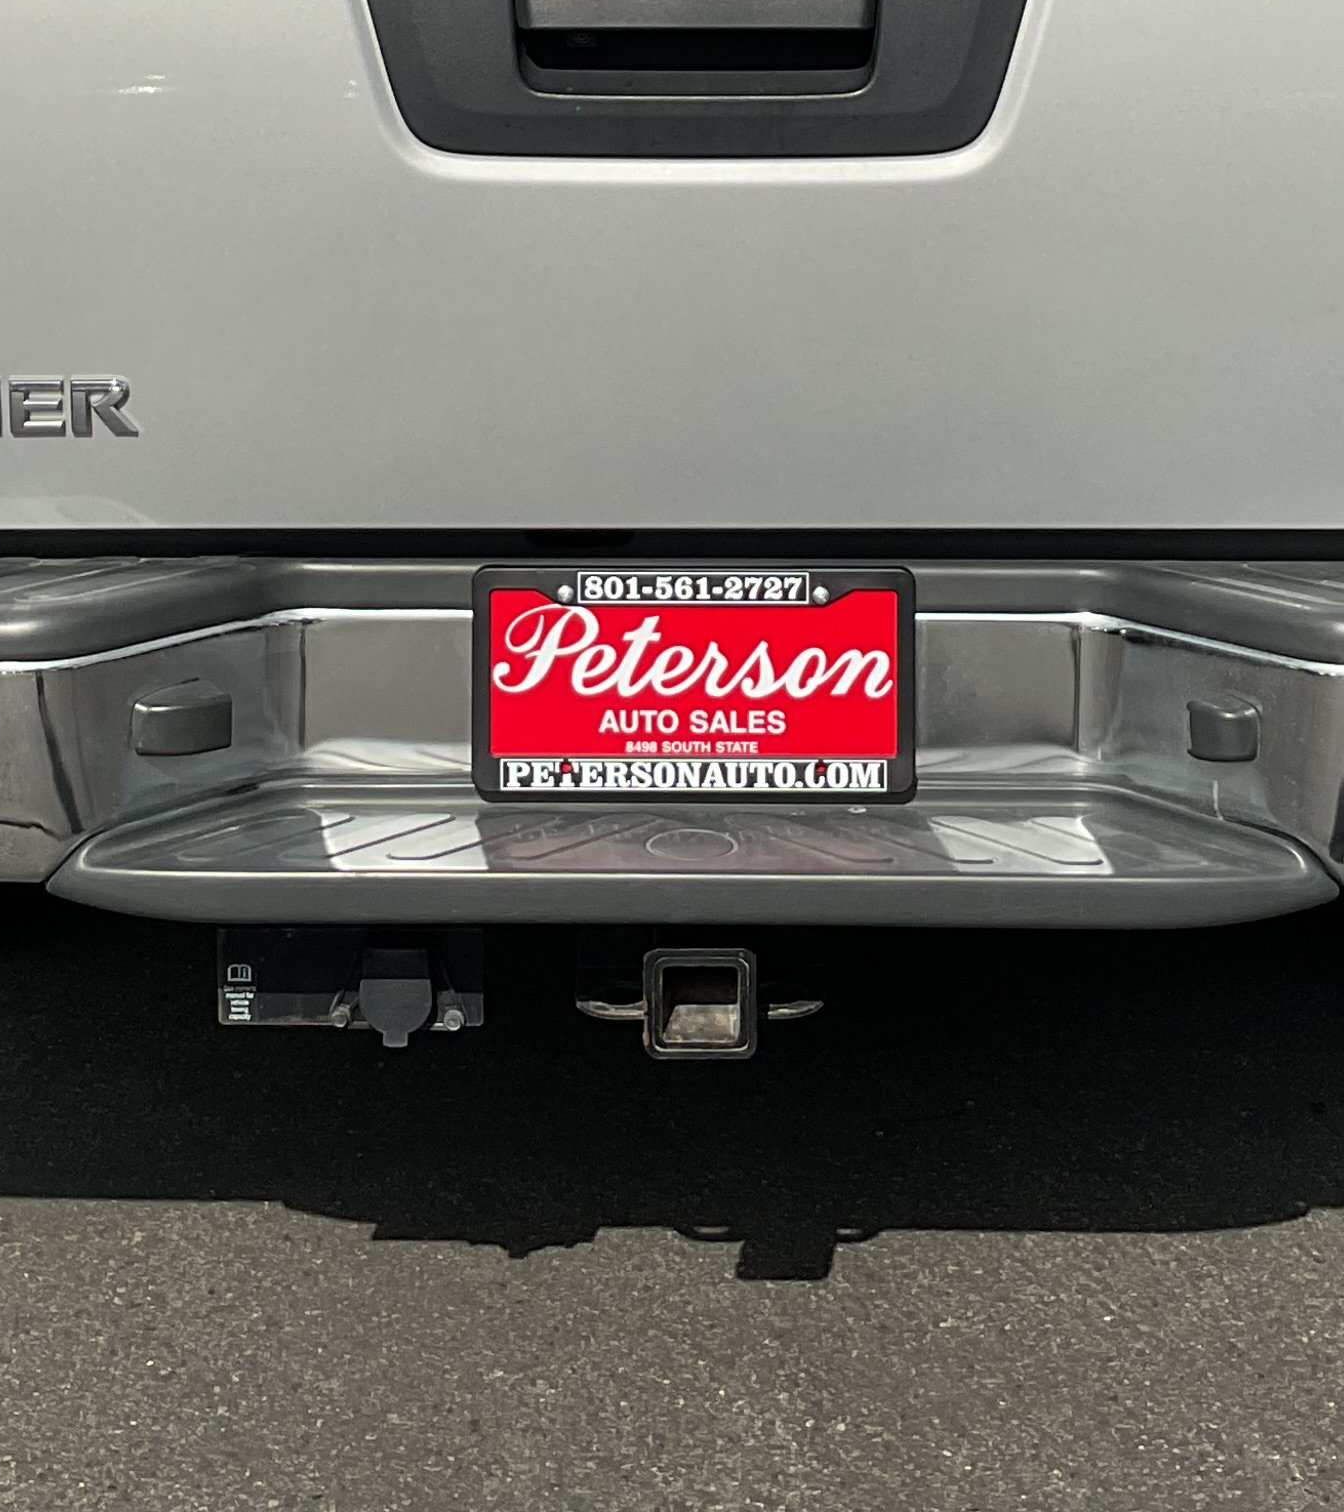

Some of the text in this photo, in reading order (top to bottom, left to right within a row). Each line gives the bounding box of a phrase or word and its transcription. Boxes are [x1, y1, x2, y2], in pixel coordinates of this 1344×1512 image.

[583, 575, 805, 600] 801-561-2727
[493, 604, 893, 699] Peterson
[599, 709, 786, 735] AUTO SALES
[625, 741, 759, 753] 8498 SOUTH STATE
[507, 760, 881, 789] PETERSONAUTO.COM
